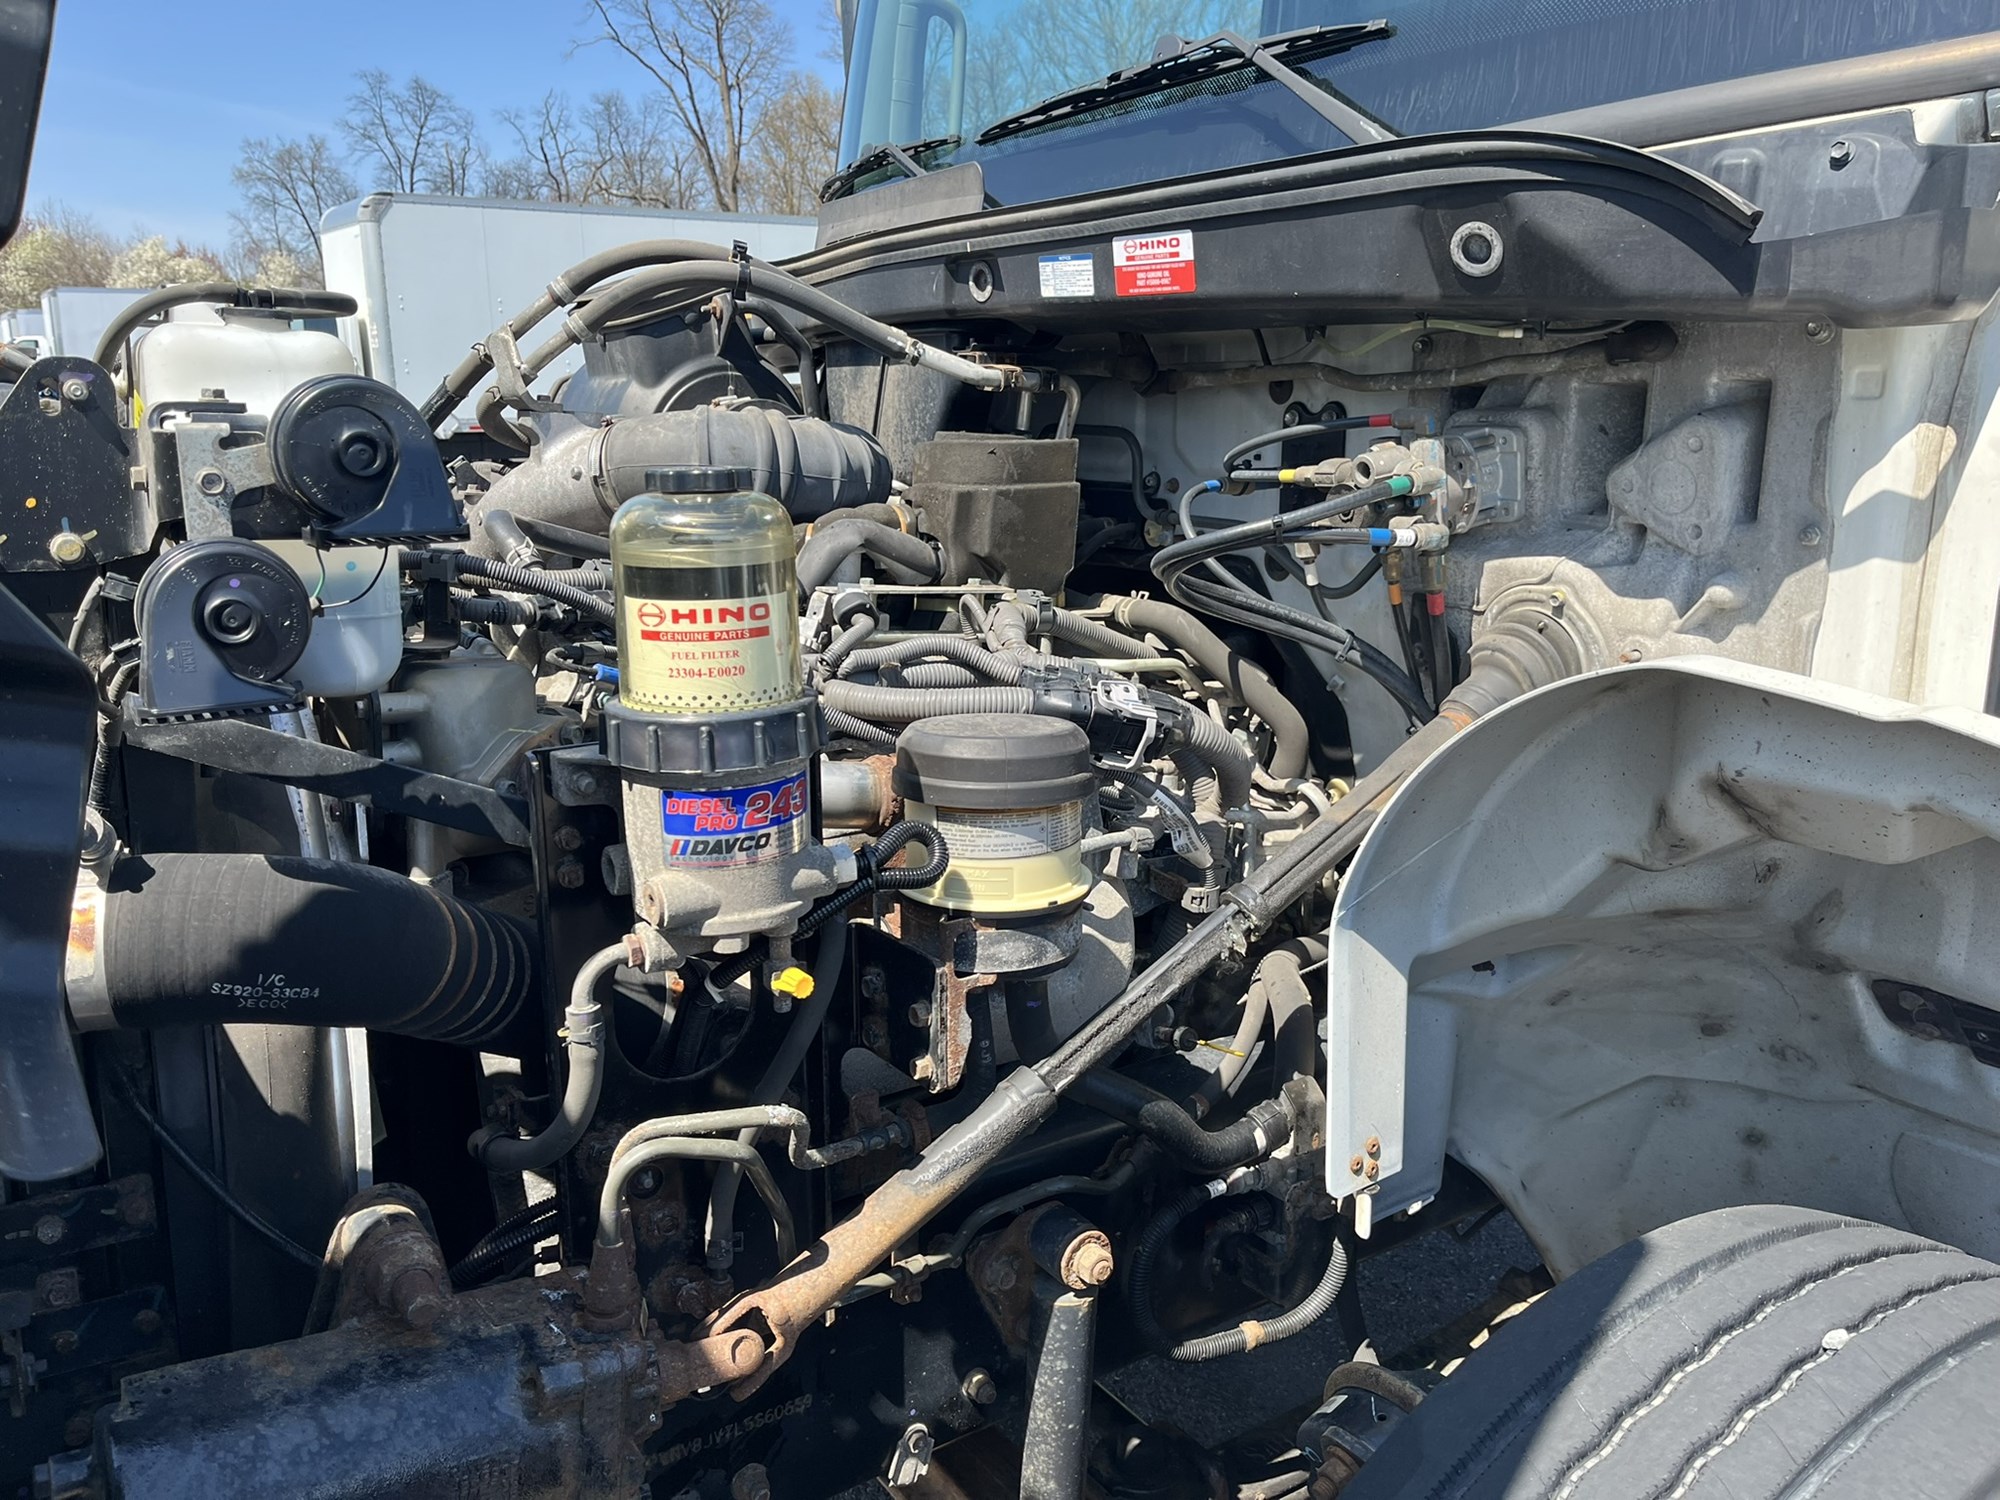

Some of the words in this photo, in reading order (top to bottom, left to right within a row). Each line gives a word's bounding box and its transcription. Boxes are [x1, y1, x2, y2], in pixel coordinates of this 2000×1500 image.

[1139, 237, 1181, 250] HINO
[671, 603, 771, 625] HINO
[659, 631, 710, 641] GENUINE
[714, 629, 750, 640] PARTS
[671, 651, 698, 661] FUEL
[701, 650, 740, 660] FILTER
[668, 665, 746, 679] 23304-E0020
[666, 796, 737, 815] DIESEL
[742, 777, 807, 829] 243
[694, 814, 739, 832] PRO
[690, 832, 771, 856] DAVCO
[258, 973, 286, 986] I/C
[210, 982, 320, 999] SZ920-33C84
